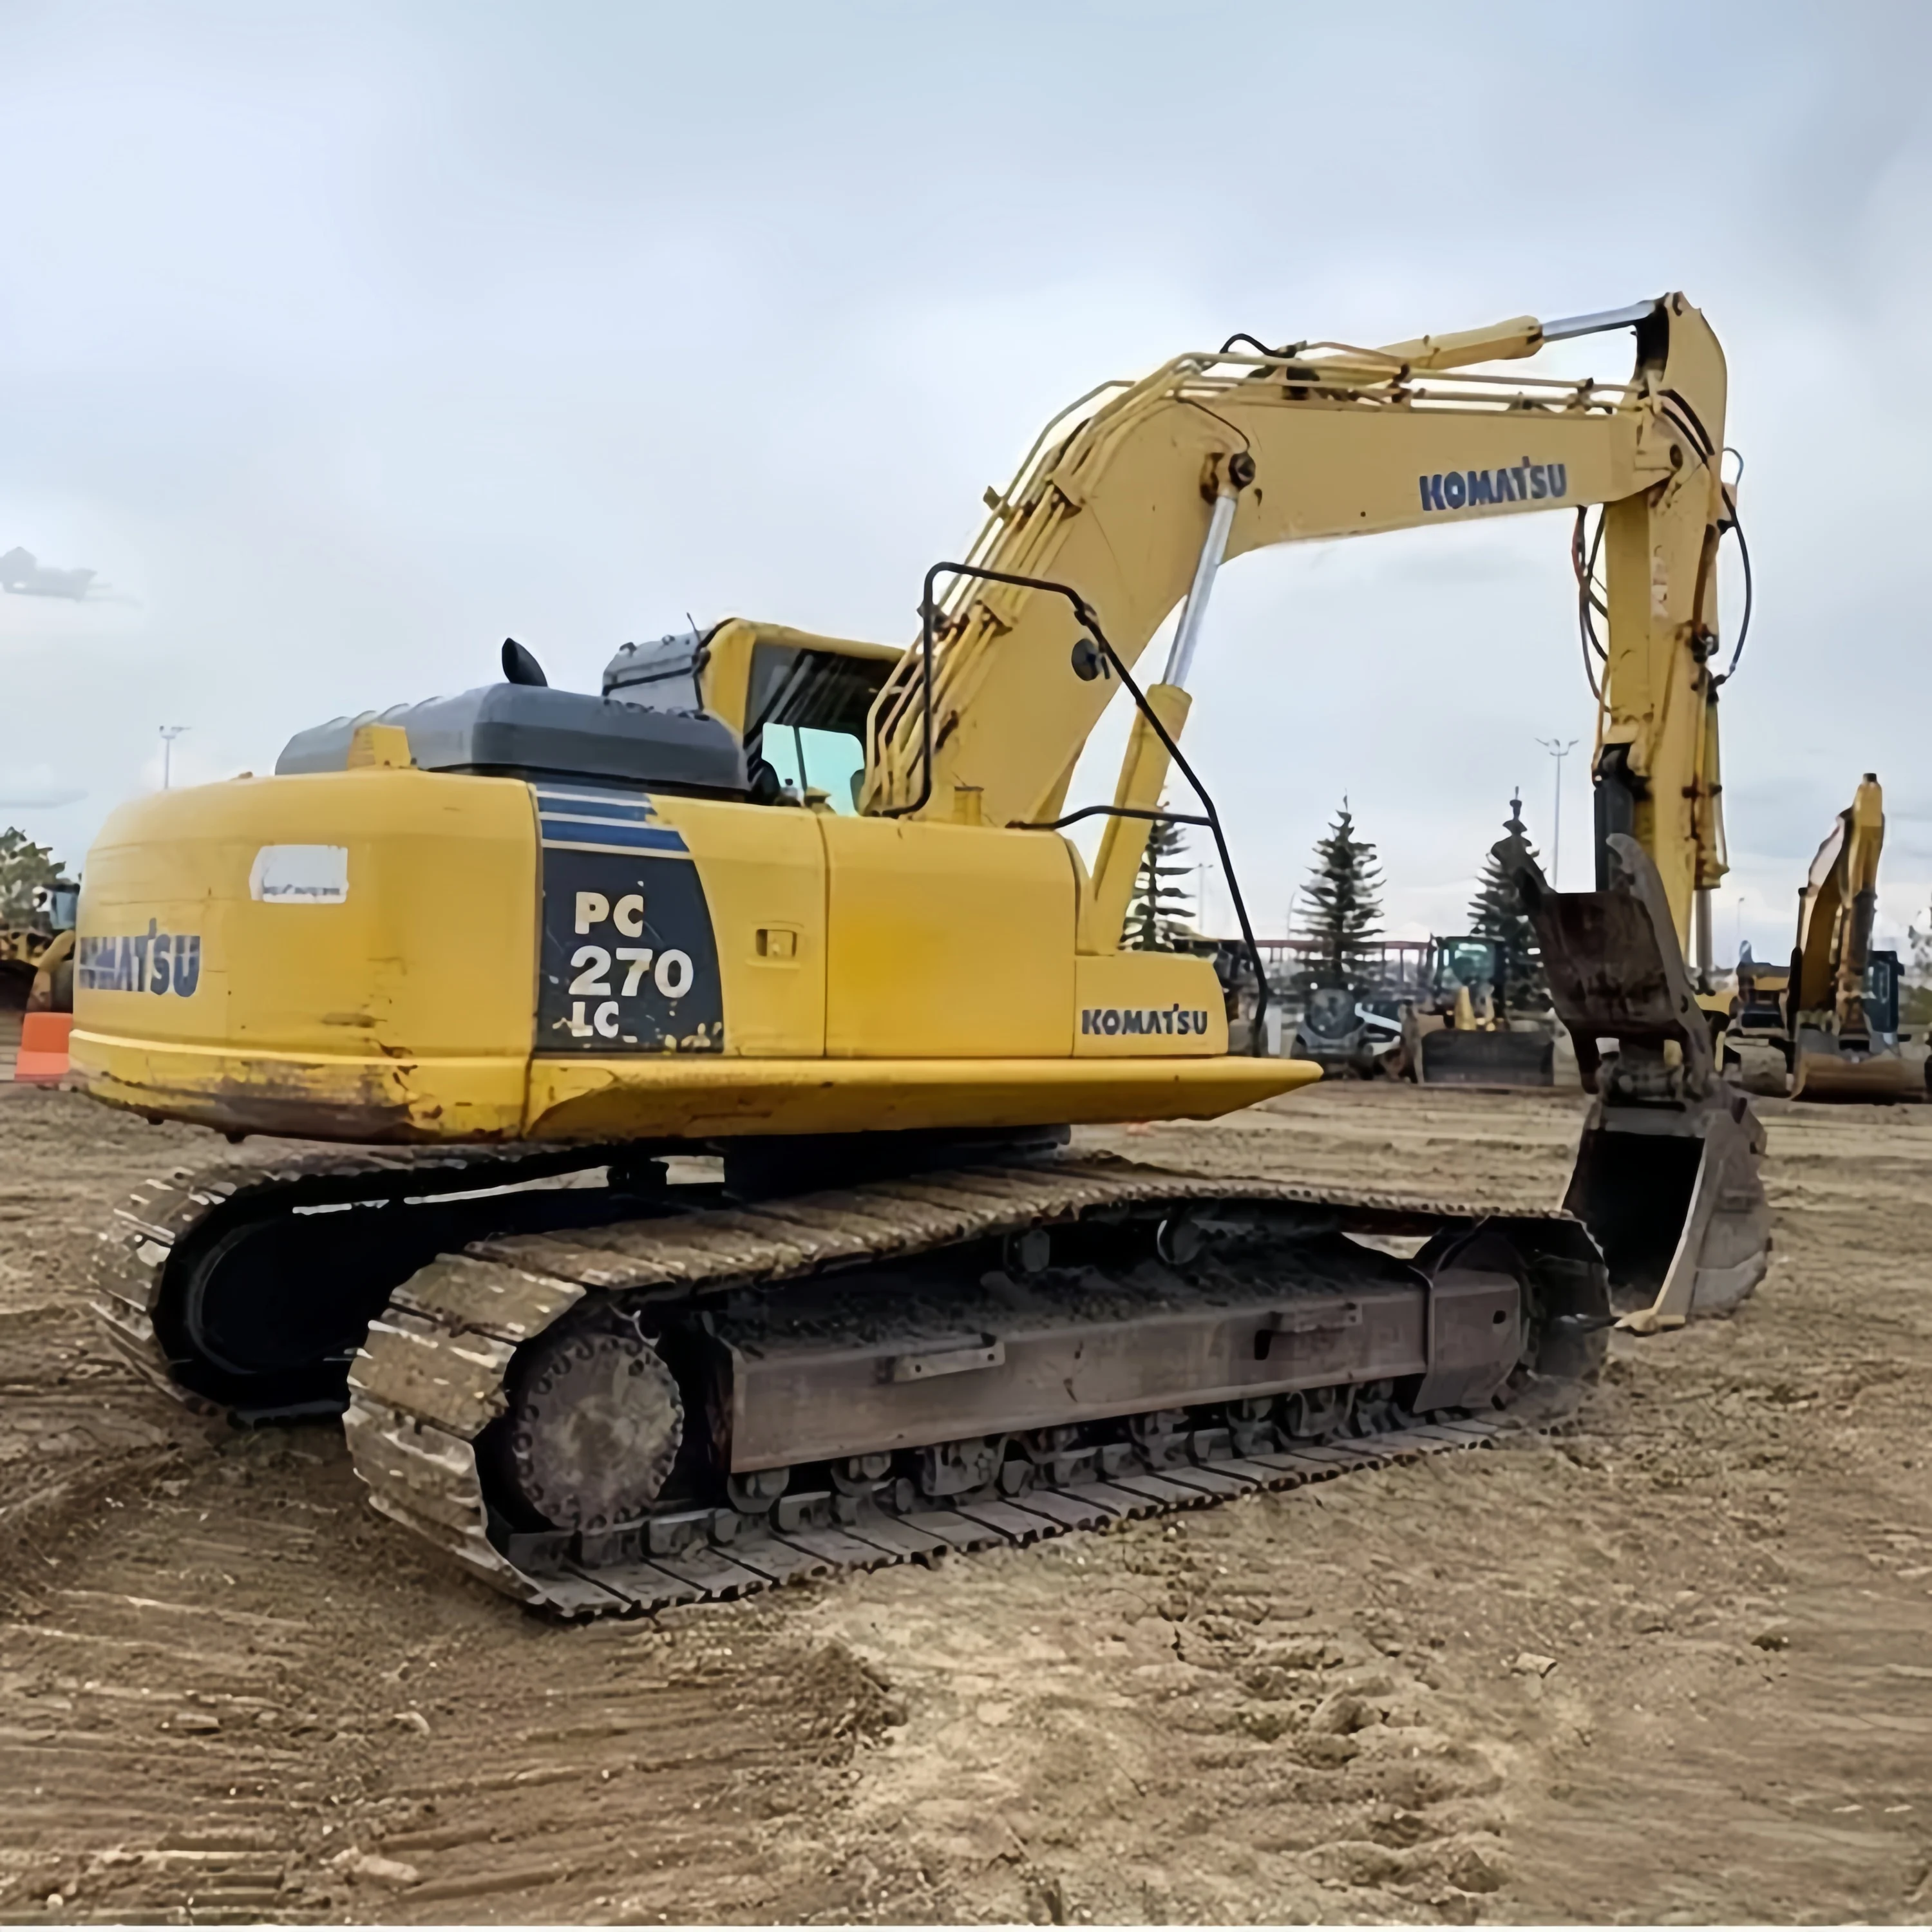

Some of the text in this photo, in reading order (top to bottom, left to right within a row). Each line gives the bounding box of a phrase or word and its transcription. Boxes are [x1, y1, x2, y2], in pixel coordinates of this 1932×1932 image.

[1419, 455, 1567, 511] KOMATSU
[575, 891, 643, 938] PC
[79, 918, 200, 997] MATSU
[569, 945, 694, 998] 270
[571, 1001, 619, 1038] LC
[1082, 1003, 1208, 1035] KOMATSU
